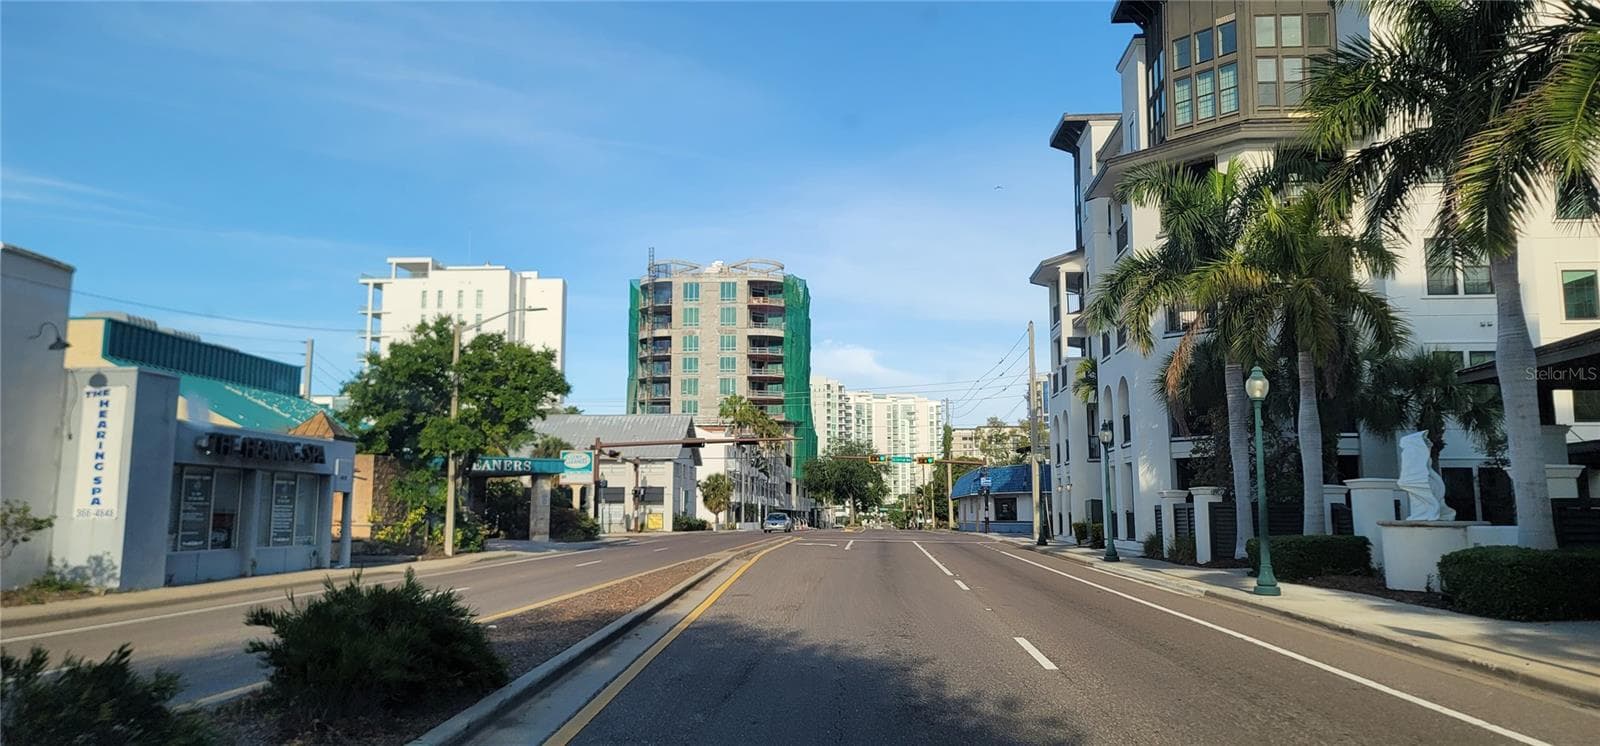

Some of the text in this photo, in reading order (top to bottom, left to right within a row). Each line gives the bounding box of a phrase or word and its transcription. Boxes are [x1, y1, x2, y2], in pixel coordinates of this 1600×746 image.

[85, 388, 110, 398] THE
[91, 400, 109, 505] HEARING SPA
[205, 432, 326, 464] THE HEARING SPA
[466, 459, 532, 472] EANERS
